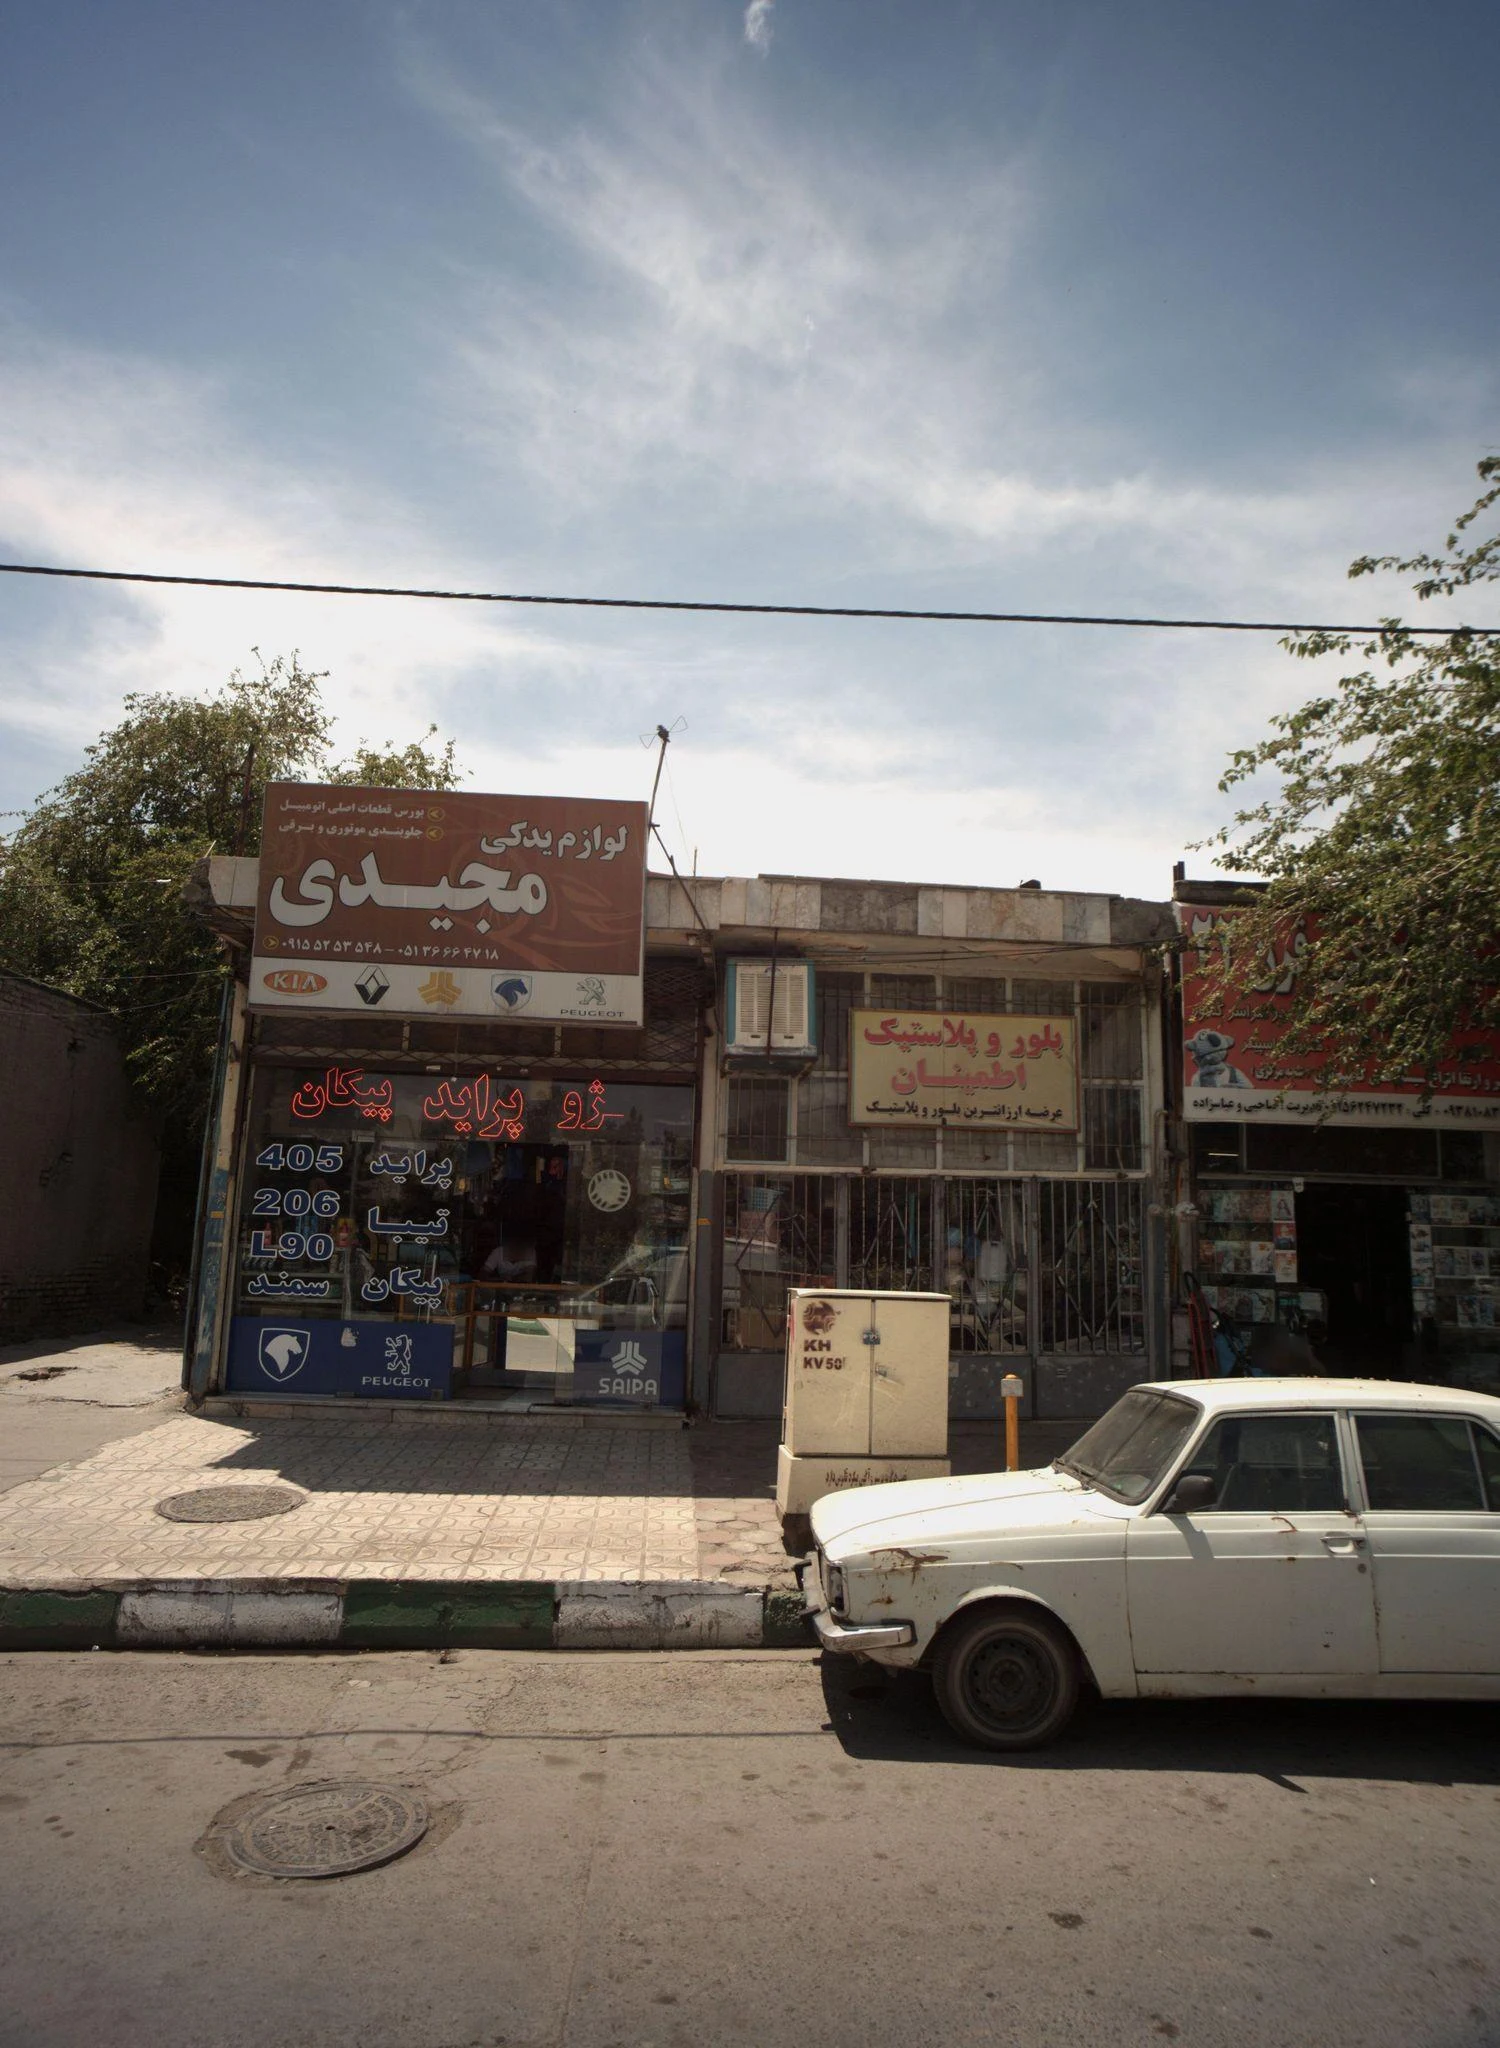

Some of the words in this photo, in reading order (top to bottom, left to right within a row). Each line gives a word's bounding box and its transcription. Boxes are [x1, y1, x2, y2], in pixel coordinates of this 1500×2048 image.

[327, 802, 356, 815] اصلی
[357, 803, 392, 815] قطعات
[394, 806, 425, 819] بورس
[278, 818, 315, 832] برقی
[317, 825, 324, 835] و
[326, 823, 366, 836] موتوری
[367, 823, 424, 839] جلوبندی
[479, 820, 553, 857] یدکی
[558, 824, 629, 861] لوازم
[269, 850, 548, 934] مجیدی
[273, 973, 318, 991] KIA
[560, 1008, 624, 1018] PEUGEOT
[864, 1018, 979, 1058] پلاستیک
[984, 1032, 1001, 1057] و
[891, 1058, 1027, 1096] اطمینان
[292, 1066, 393, 1122] پیکان
[423, 1073, 524, 1140] پراید
[866, 1100, 919, 1118] پلاستیک
[1025, 1105, 1063, 1122] عرضه
[256, 1143, 344, 1173] 405
[369, 1149, 453, 1189] پراید
[251, 1188, 341, 1217] 206
[368, 1206, 451, 1244] تیبا
[250, 1231, 335, 1260] L90
[248, 1270, 330, 1296] سمند
[361, 1266, 443, 1310] پیکان
[803, 1339, 832, 1352] KH
[361, 1376, 432, 1388] PEUGEOT
[598, 1378, 658, 1396] SAIPA
